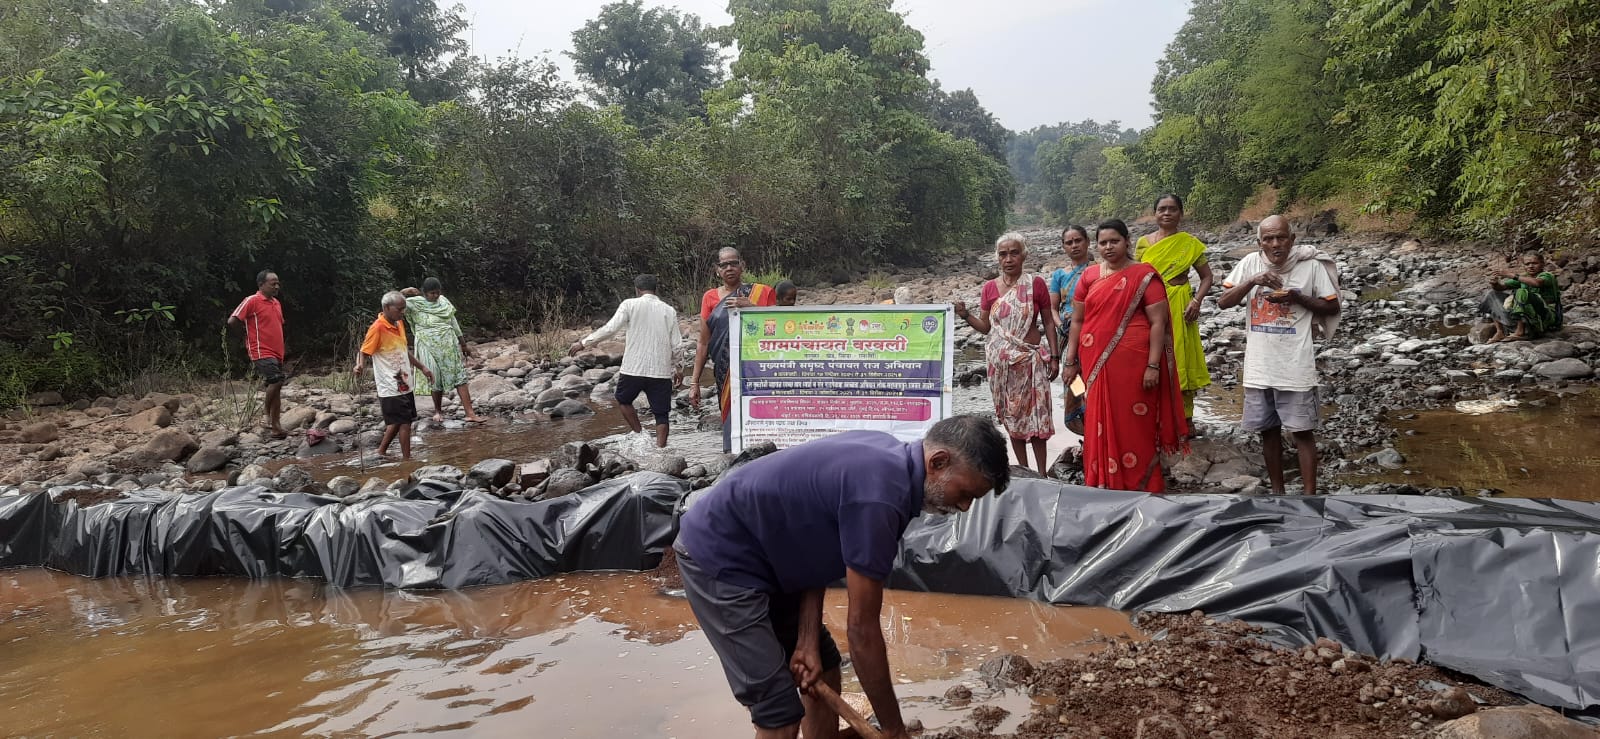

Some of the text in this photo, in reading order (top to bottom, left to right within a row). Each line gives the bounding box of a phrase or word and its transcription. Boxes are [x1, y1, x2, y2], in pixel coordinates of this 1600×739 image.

[759, 335, 907, 351] ग्रामपंचायत वरवली
[759, 360, 796, 371] मुख्यमंत्री
[828, 360, 859, 369] पंचायत
[884, 361, 922, 369] अभियान
